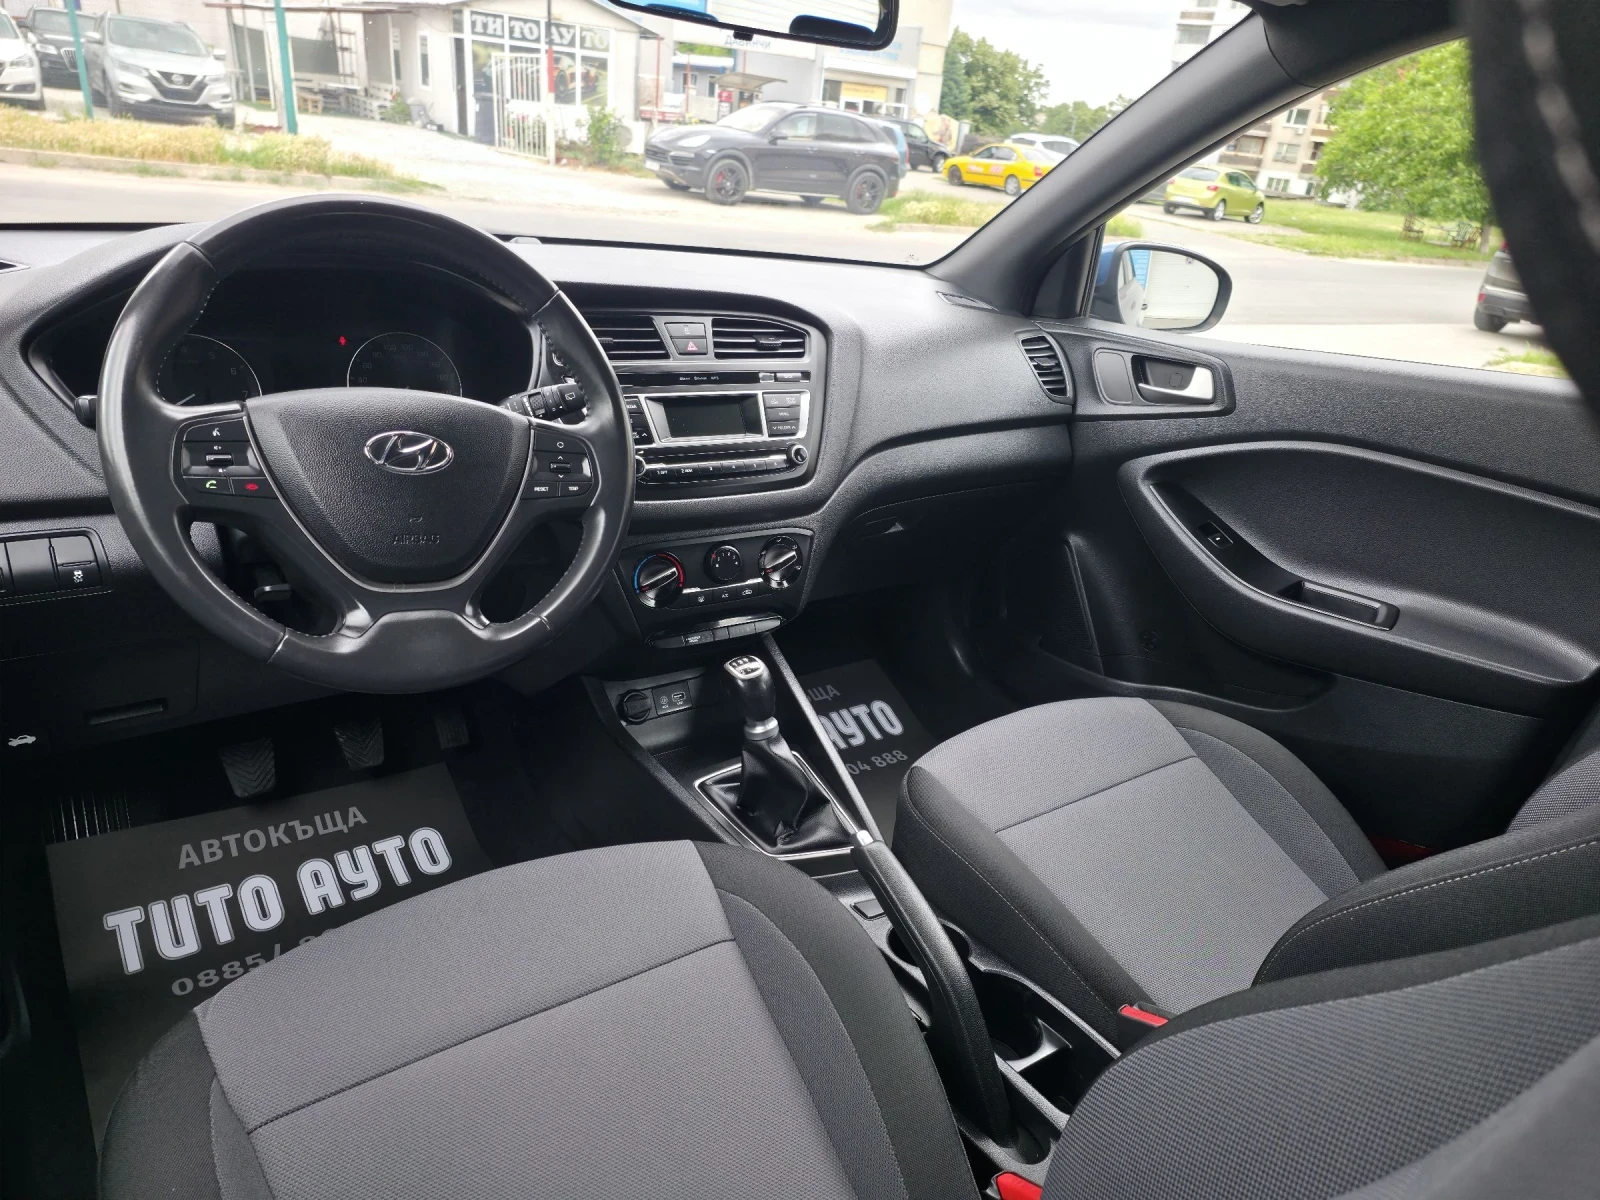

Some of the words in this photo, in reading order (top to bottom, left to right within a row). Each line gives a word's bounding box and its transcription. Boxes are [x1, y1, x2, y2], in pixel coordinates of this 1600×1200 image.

[806, 685, 841, 701] ЩА
[871, 750, 908, 767] 888
[177, 806, 368, 870] АВТОКЪЩА
